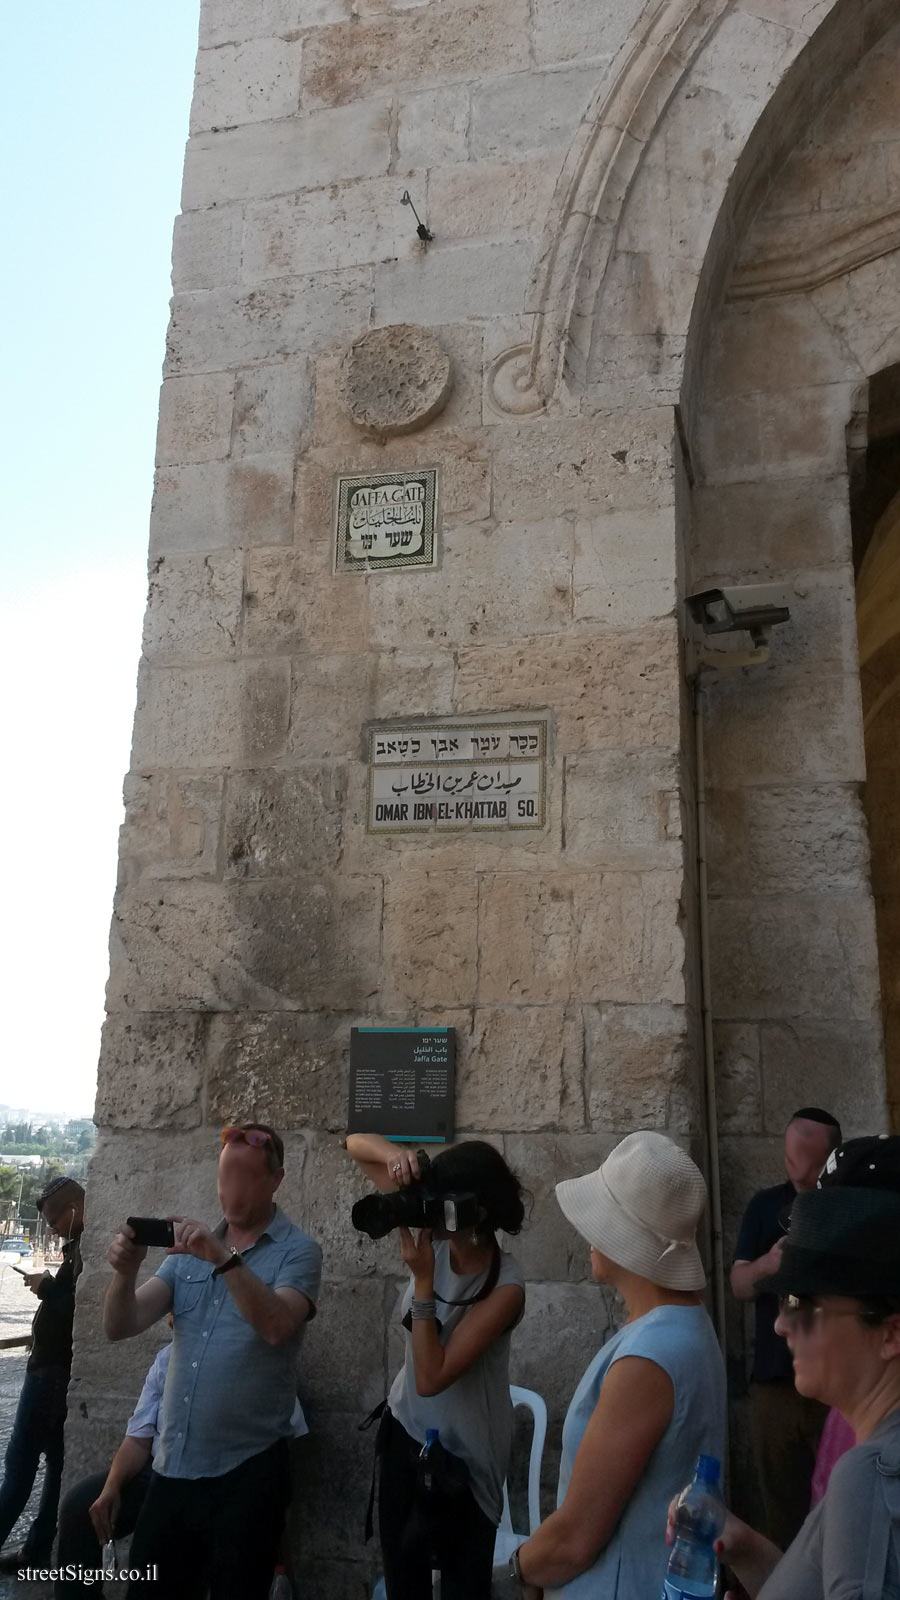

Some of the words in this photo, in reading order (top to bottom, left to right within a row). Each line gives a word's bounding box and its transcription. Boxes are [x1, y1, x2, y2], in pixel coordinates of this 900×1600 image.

[353, 490, 388, 507] JAFFA
[391, 486, 424, 502] GATE
[361, 533, 377, 550] יפו
[385, 530, 413, 548] שער
[392, 772, 440, 796] الخطاب
[443, 776, 462, 795] بن
[456, 771, 479, 792] عمر
[477, 770, 521, 795] ميدان
[375, 804, 408, 821] OMAR
[413, 803, 433, 820] IBN
[438, 801, 507, 819] EL-KHATTAB
[517, 800, 538, 818] SQ.
[414, 1055, 430, 1063] Jaffa
[431, 1055, 448, 1063] Gate
